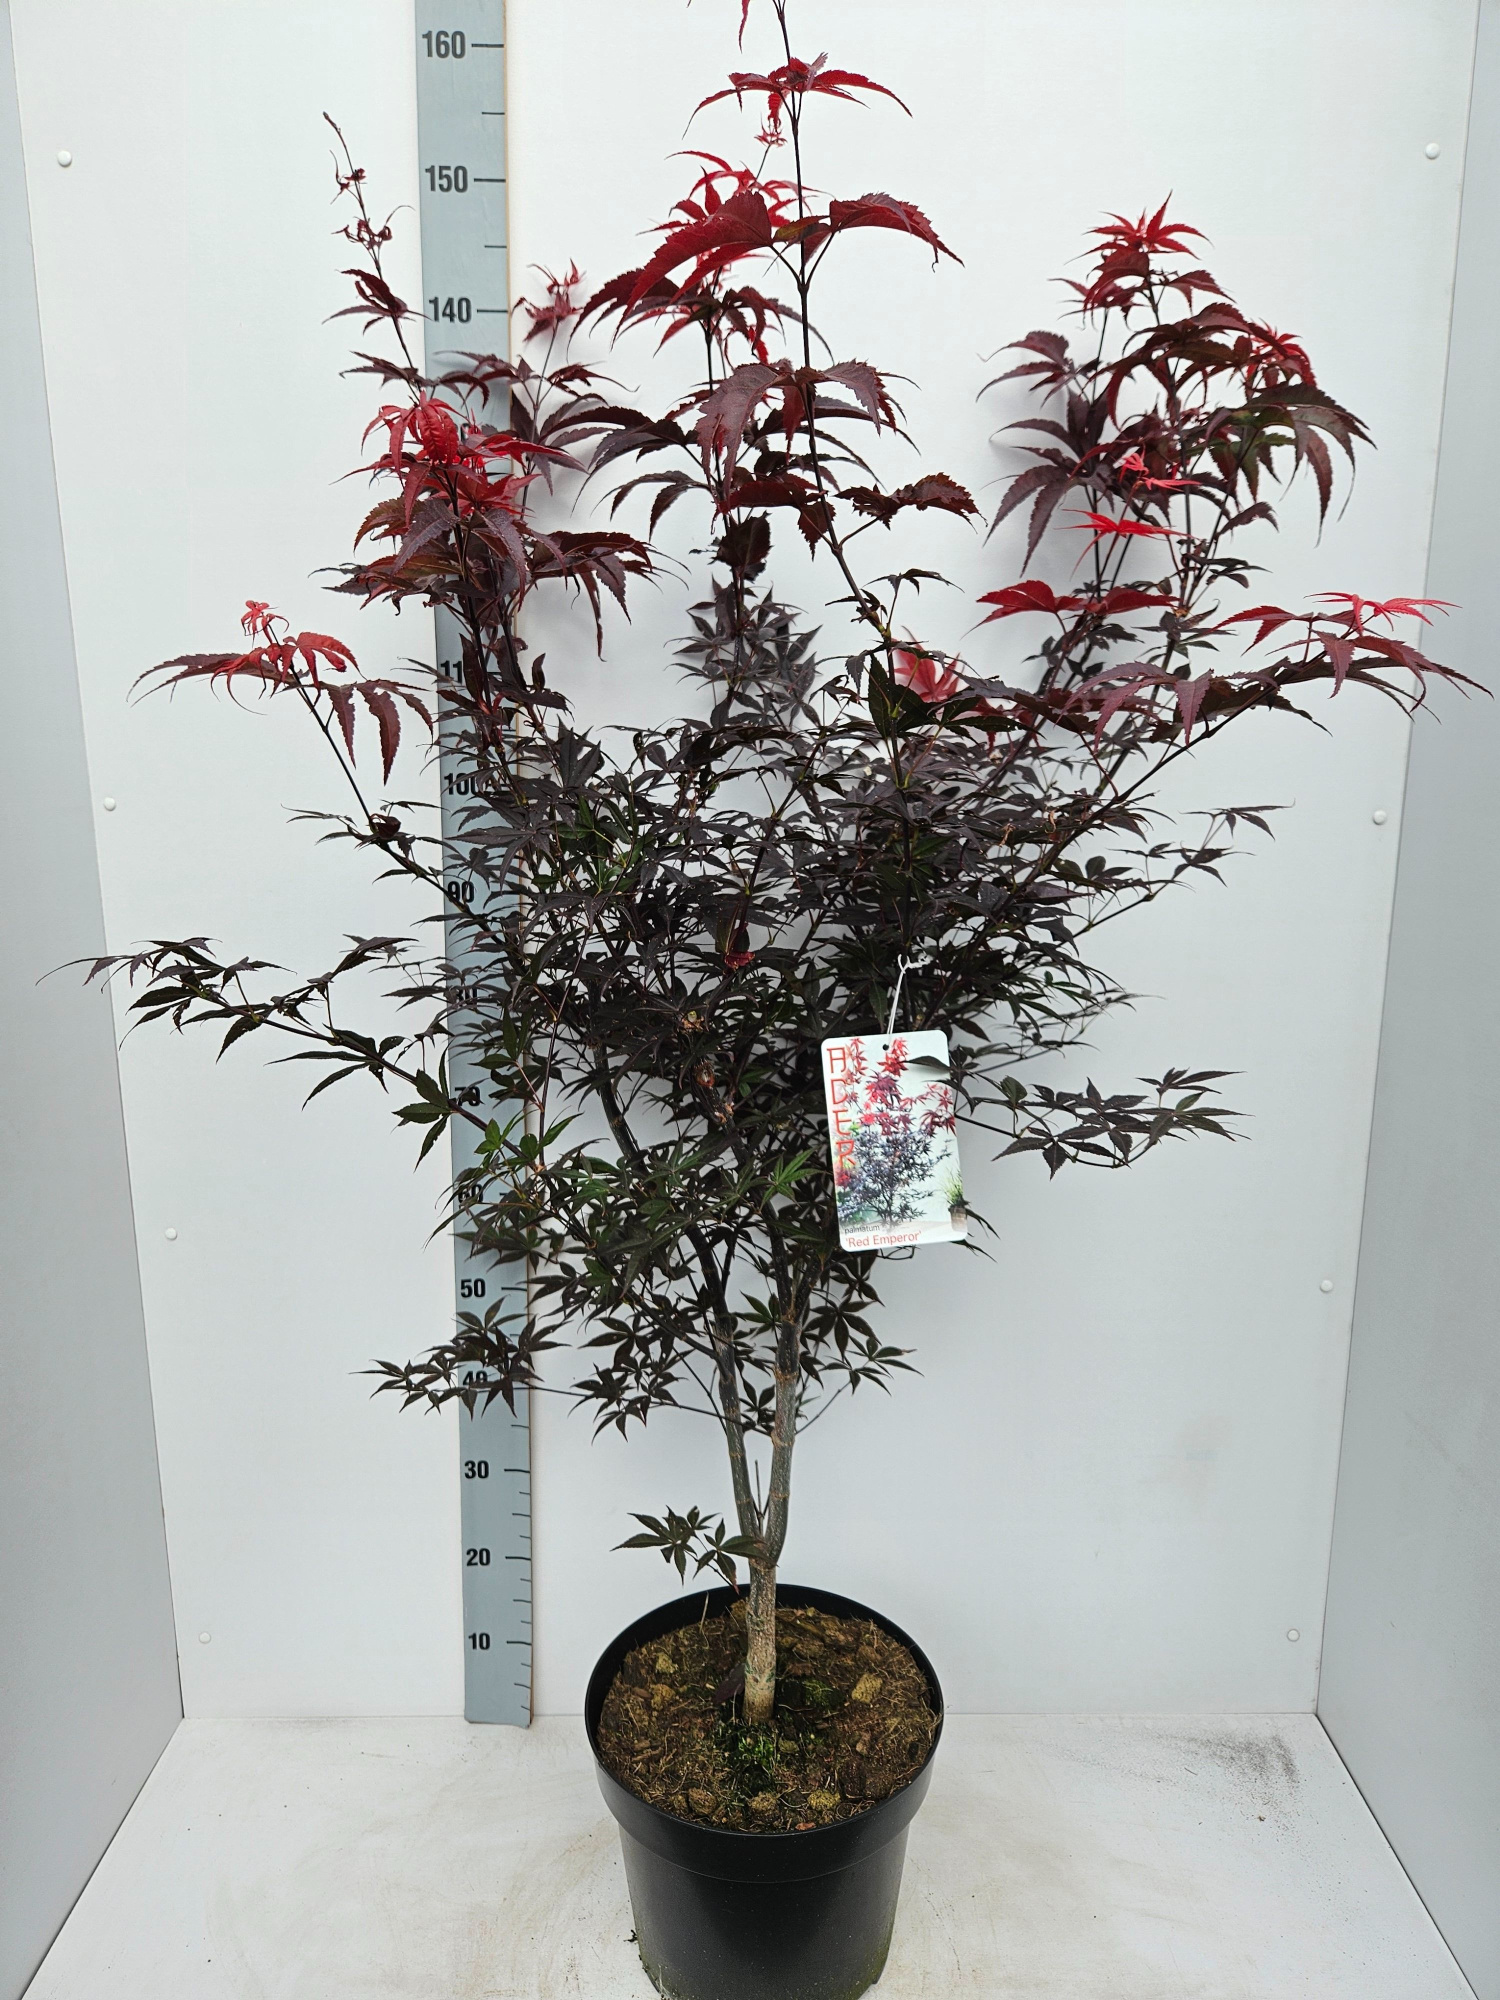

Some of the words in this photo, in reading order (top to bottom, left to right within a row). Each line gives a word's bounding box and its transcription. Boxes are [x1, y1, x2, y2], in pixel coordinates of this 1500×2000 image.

[422, 30, 466, 59] 160
[425, 165, 468, 194] 150
[428, 297, 473, 324] 140
[441, 660, 464, 685] 11
[447, 881, 475, 903] 90
[844, 1224, 881, 1236] palmatum
[460, 1278, 486, 1298] 50
[462, 1370, 488, 1387] 40
[464, 1460, 489, 1478] 30
[466, 1548, 491, 1567] 20
[468, 1633, 491, 1650] 10
